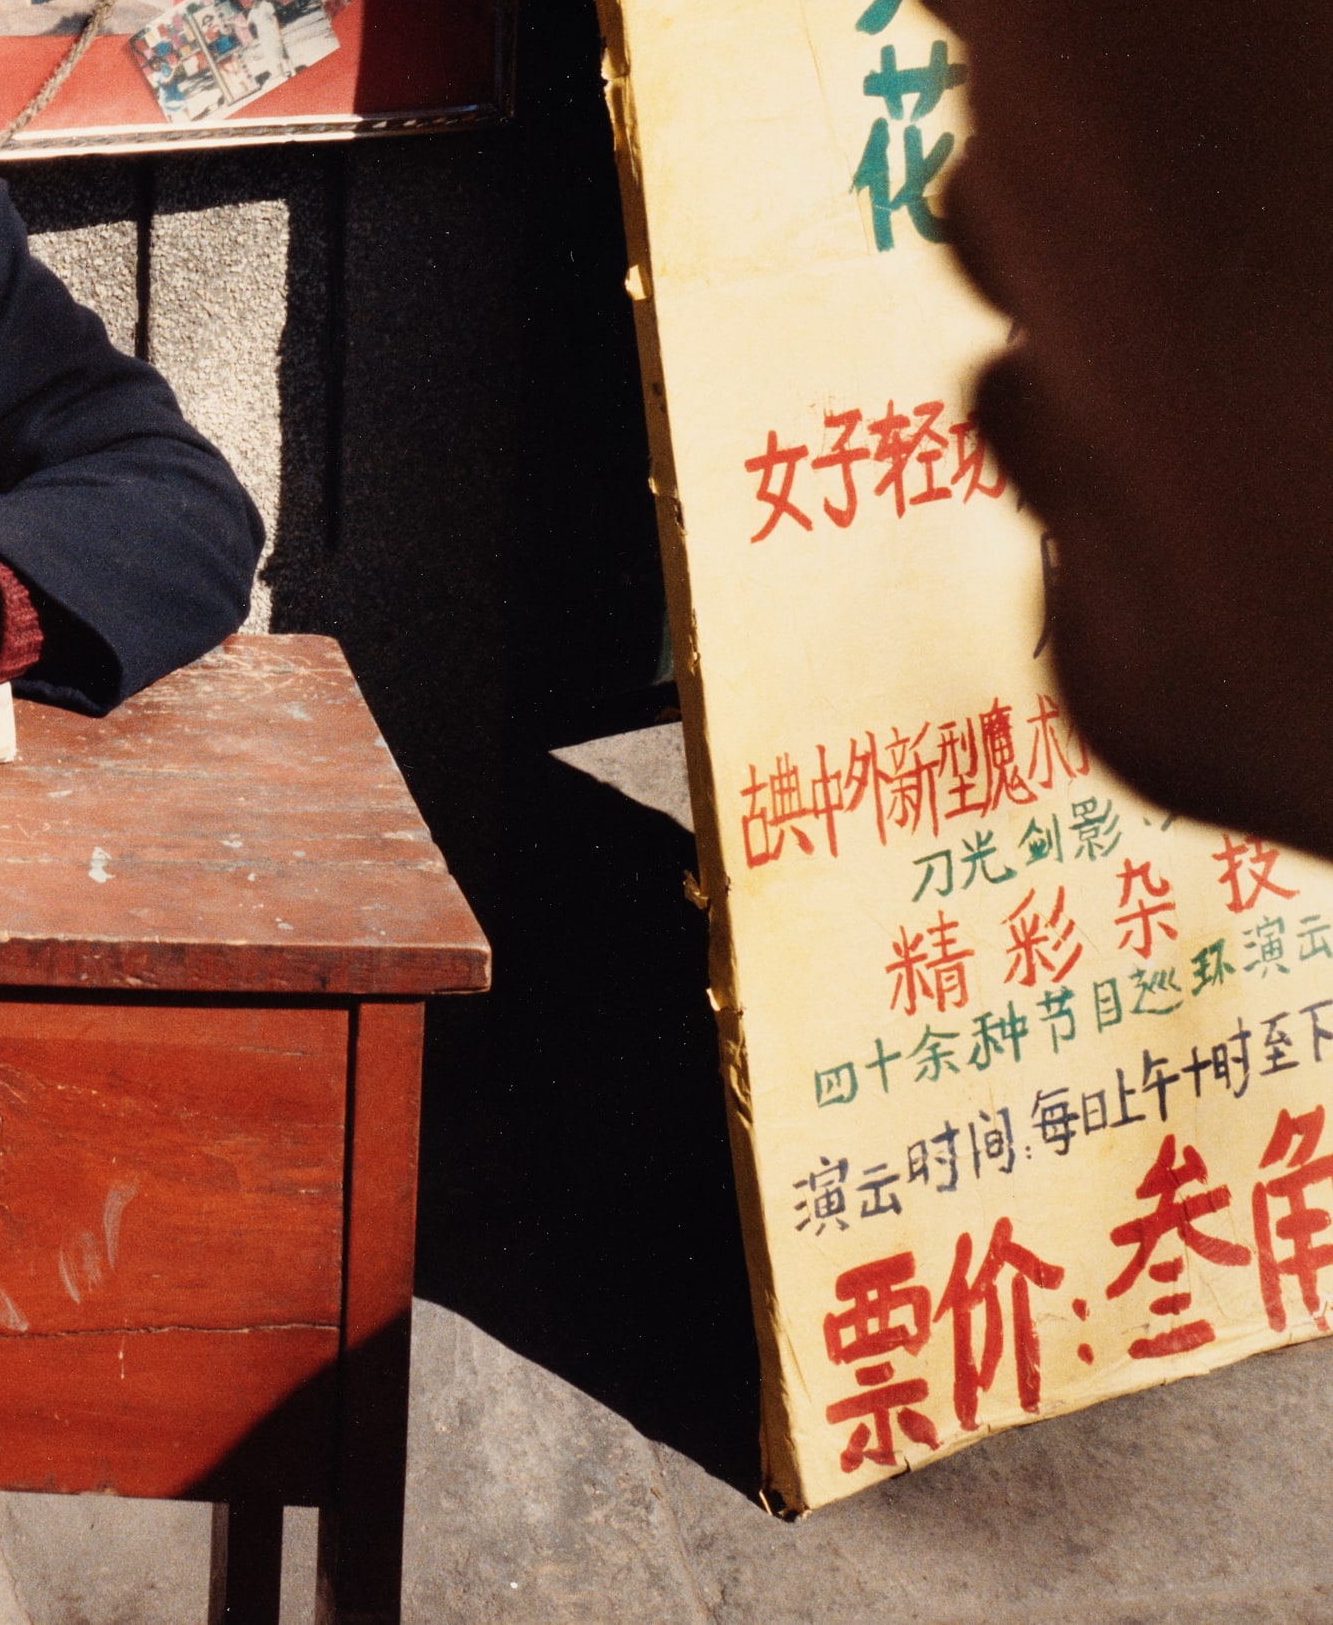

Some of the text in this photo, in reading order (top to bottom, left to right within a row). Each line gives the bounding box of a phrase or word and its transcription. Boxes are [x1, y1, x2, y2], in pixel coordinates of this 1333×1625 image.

[740, 693, 1091, 869] 古典中外新型魔术
[911, 794, 1176, 902] 刀光剑影
[884, 832, 1301, 1016] 精彩杂技
